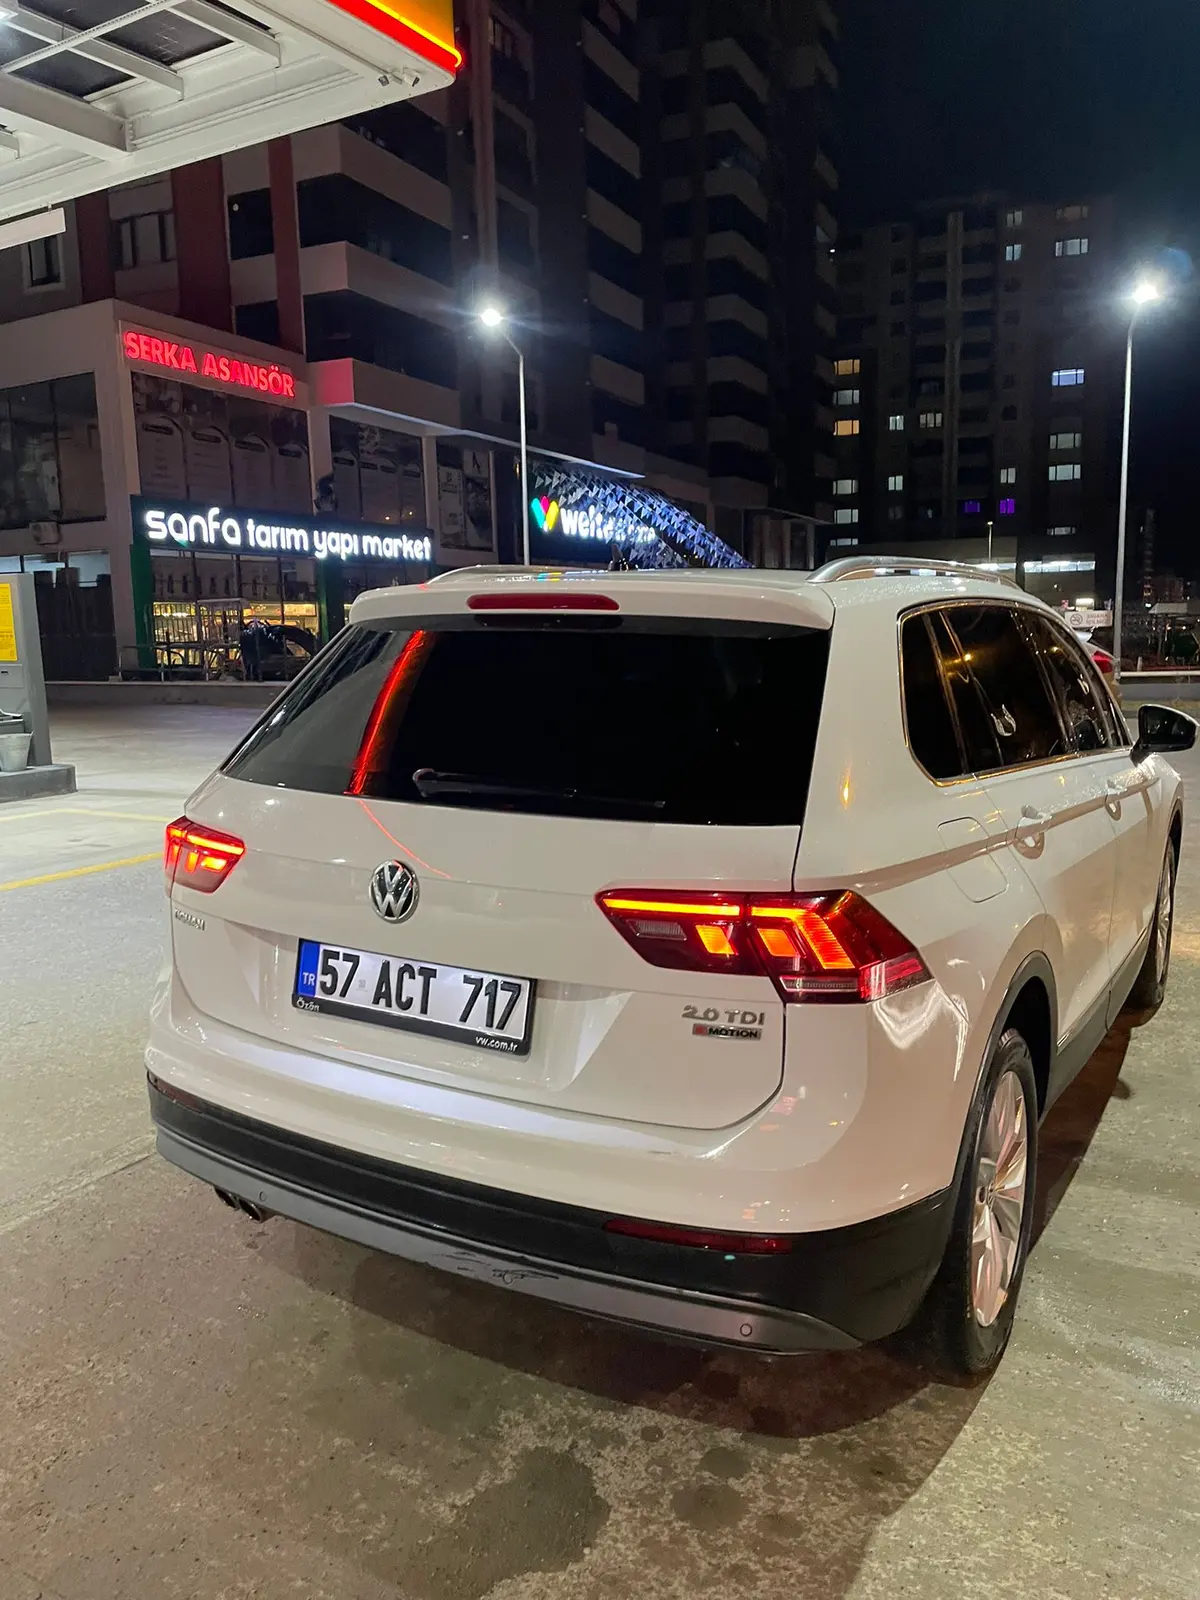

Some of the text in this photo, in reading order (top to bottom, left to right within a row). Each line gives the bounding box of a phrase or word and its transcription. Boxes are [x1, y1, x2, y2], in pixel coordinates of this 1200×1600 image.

[124, 331, 295, 398] SERKA ASANSÖR
[145, 507, 431, 560] sanfa tarım yapı market
[302, 971, 316, 986] TR
[319, 949, 522, 1031] 57 ACT 717
[724, 1009, 766, 1026] TDI
[694, 1024, 759, 1039] MOTION
[475, 1036, 518, 1052] vw.com.tr
